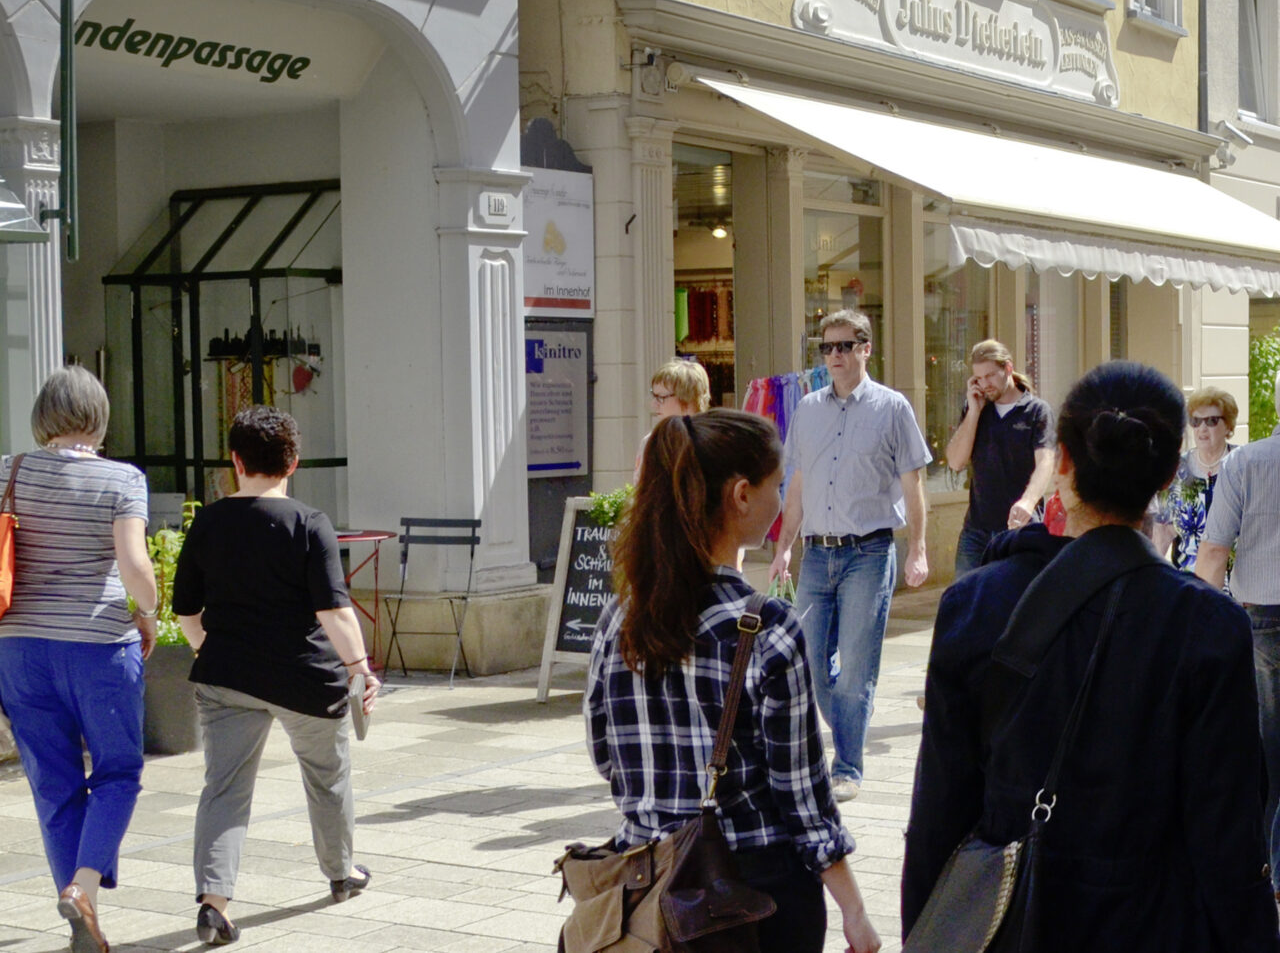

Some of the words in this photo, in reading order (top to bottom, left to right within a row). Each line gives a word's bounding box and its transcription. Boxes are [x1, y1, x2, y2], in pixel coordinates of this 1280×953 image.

[73, 18, 310, 83] ndenpassage
[556, 285, 591, 297] Innenhof
[534, 342, 582, 359] kinitro
[574, 554, 615, 572] SCHMU
